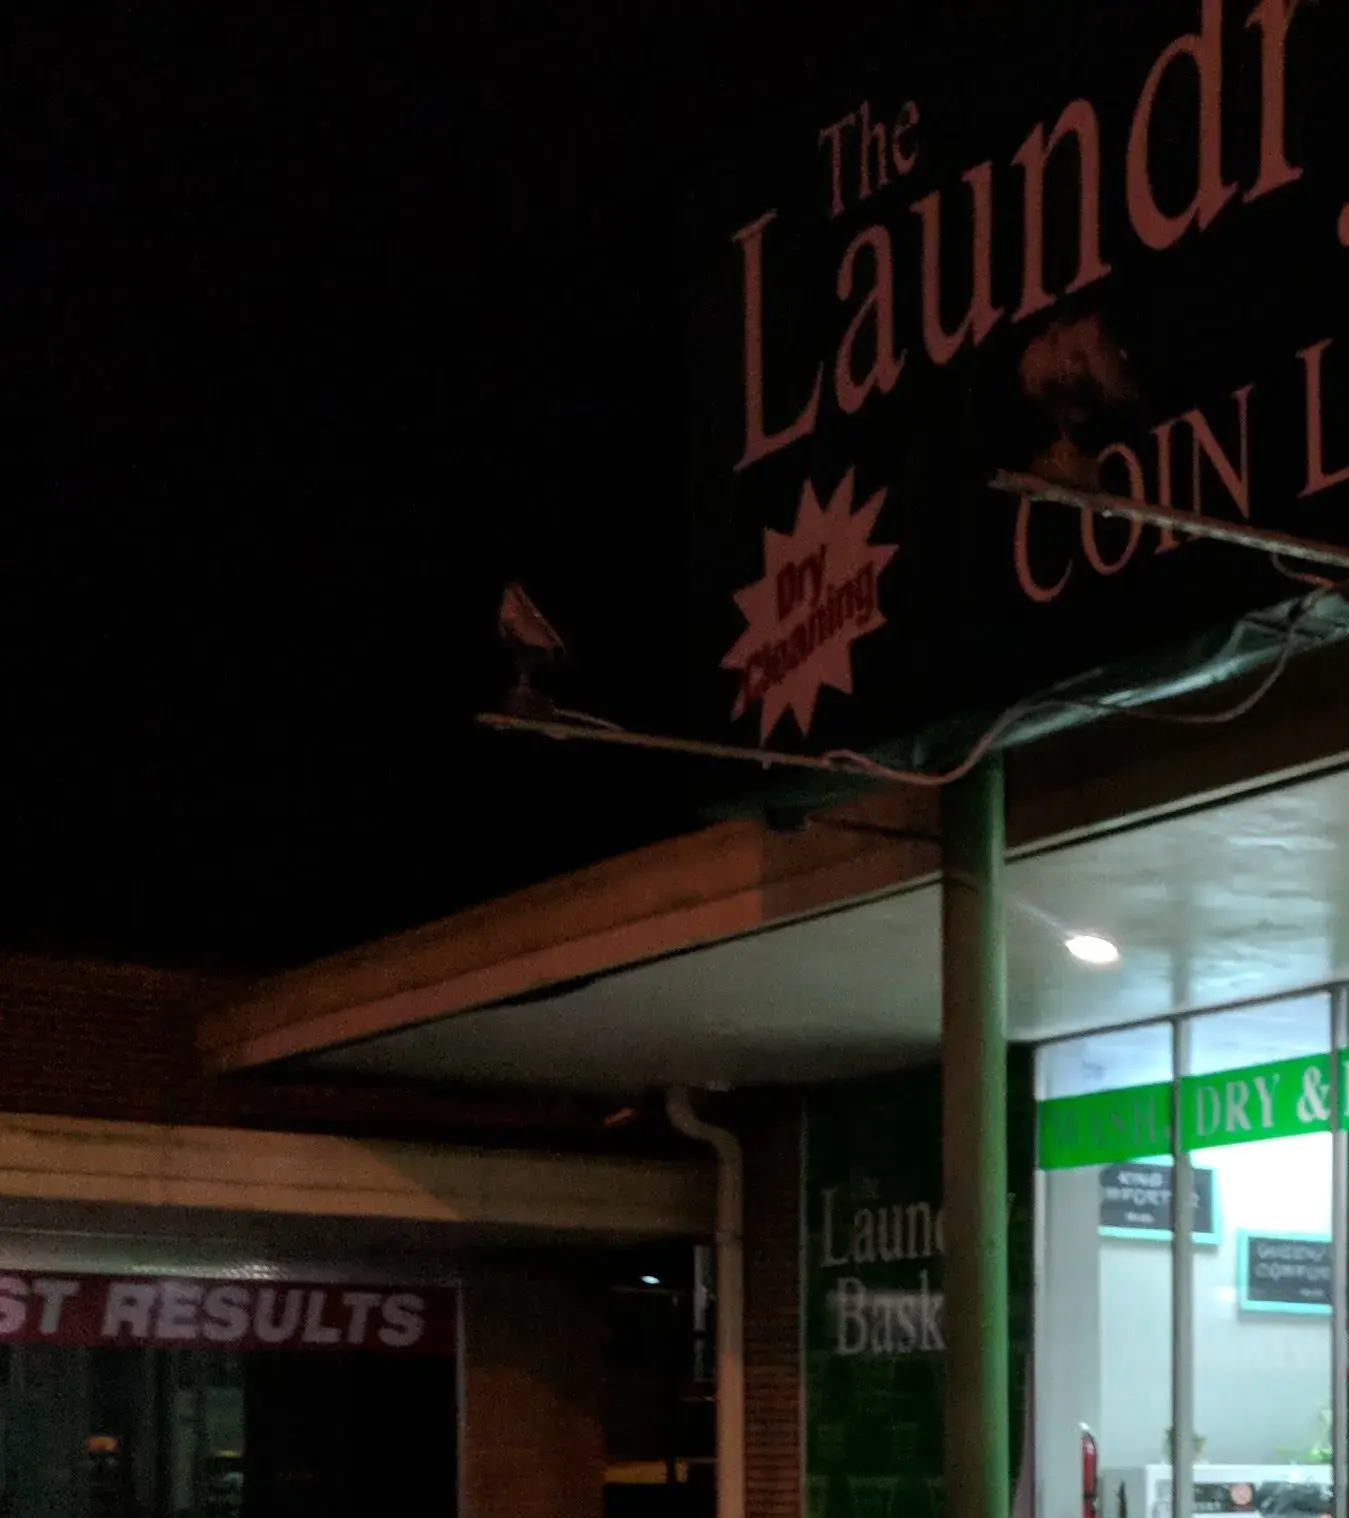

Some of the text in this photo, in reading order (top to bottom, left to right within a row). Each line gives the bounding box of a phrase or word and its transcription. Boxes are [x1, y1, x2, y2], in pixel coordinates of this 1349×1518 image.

[818, 100, 920, 218] The
[1013, 384, 1258, 602] COIN
[1196, 1072, 1281, 1138] DRY
[1296, 1064, 1332, 1122] &
[821, 1187, 946, 1268] Laun
[100, 1281, 425, 1348] RESULTS
[834, 1270, 947, 1357] Bask
